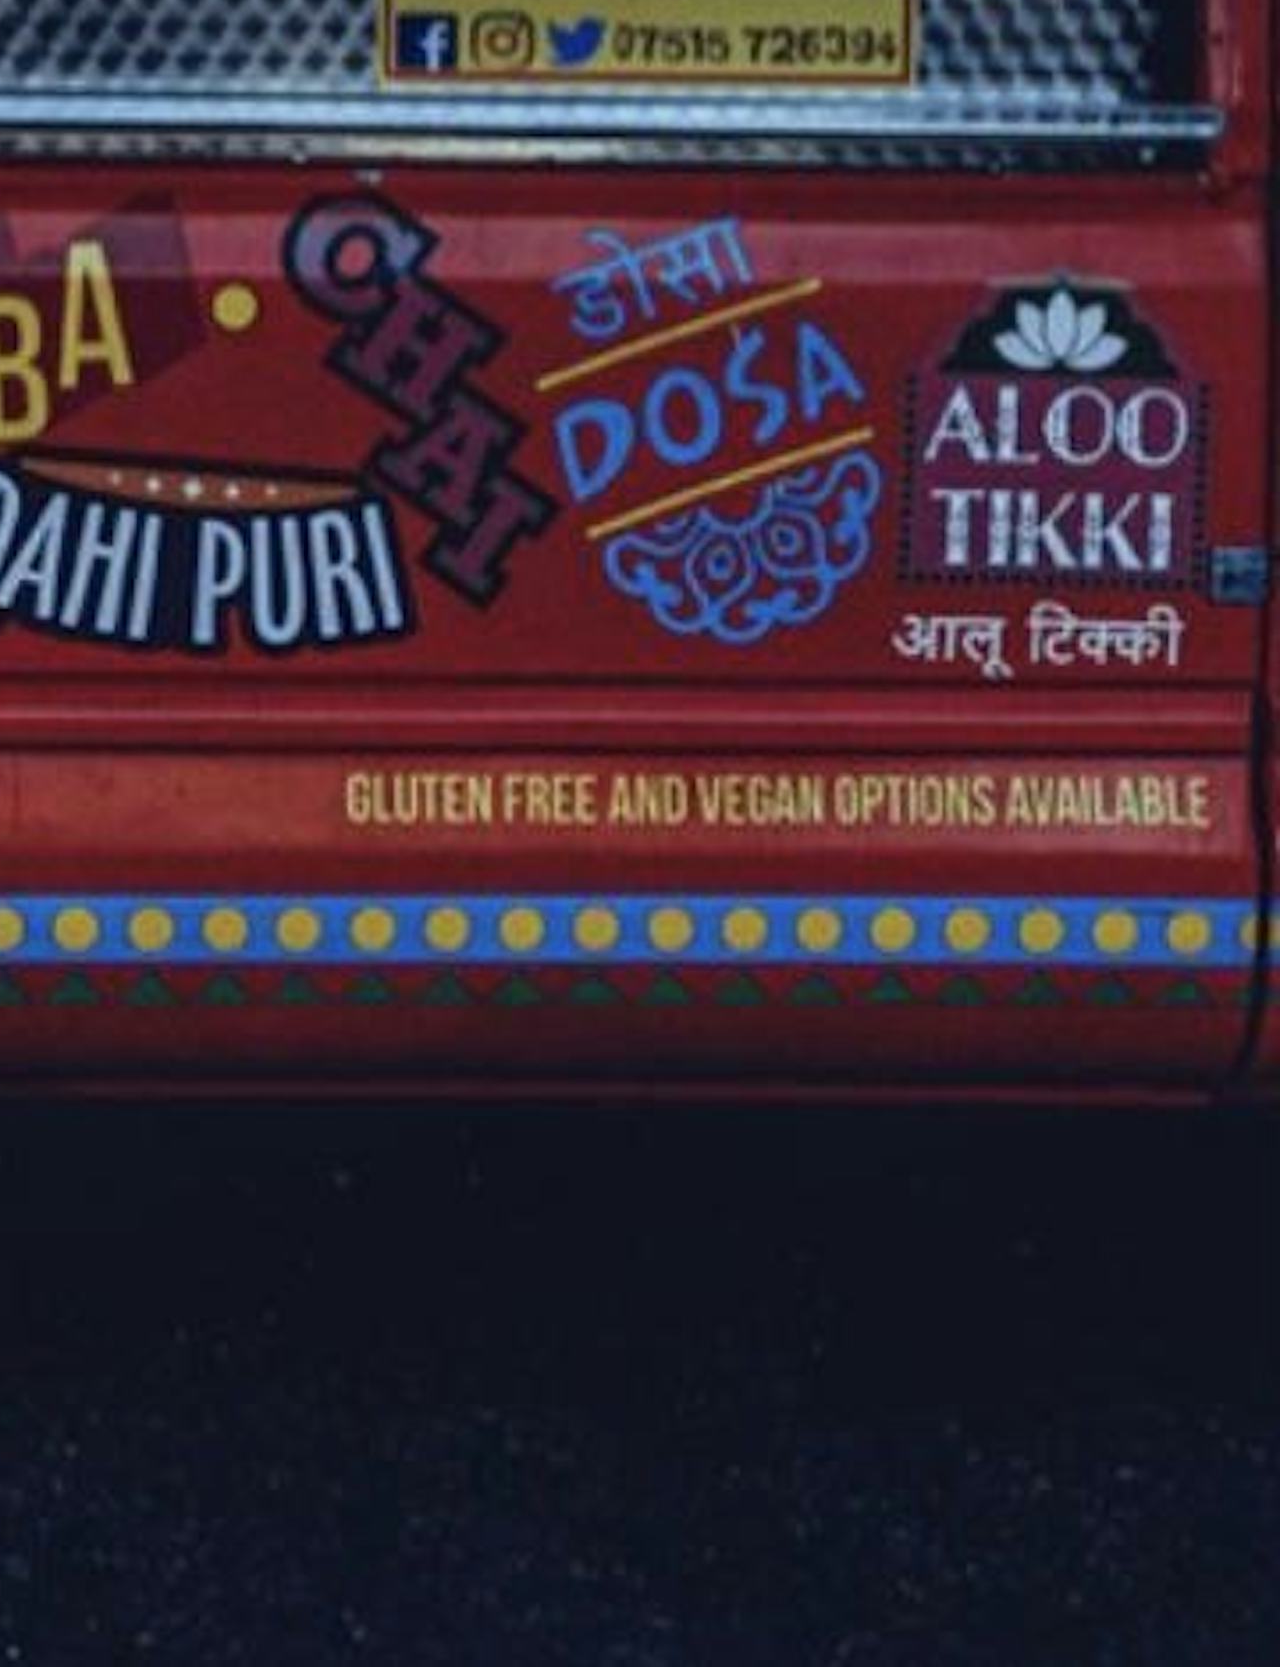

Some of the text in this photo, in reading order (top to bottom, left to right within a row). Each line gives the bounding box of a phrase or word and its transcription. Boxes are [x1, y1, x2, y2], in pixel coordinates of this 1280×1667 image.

[611, 22, 731, 62] 07515
[745, 25, 897, 63] 726394
[551, 216, 756, 338] डोसा
[285, 195, 559, 606] CHAI
[554, 320, 866, 502] DOSA
[923, 383, 1189, 469] ALOO
[929, 487, 1174, 571] TIKKI
[190, 501, 405, 646] PURI
[892, 598, 1186, 680] आलू टिक्की
[346, 772, 1210, 829] GLUTEN FREE AND VEGAN OPTIONS AVAILABLE
